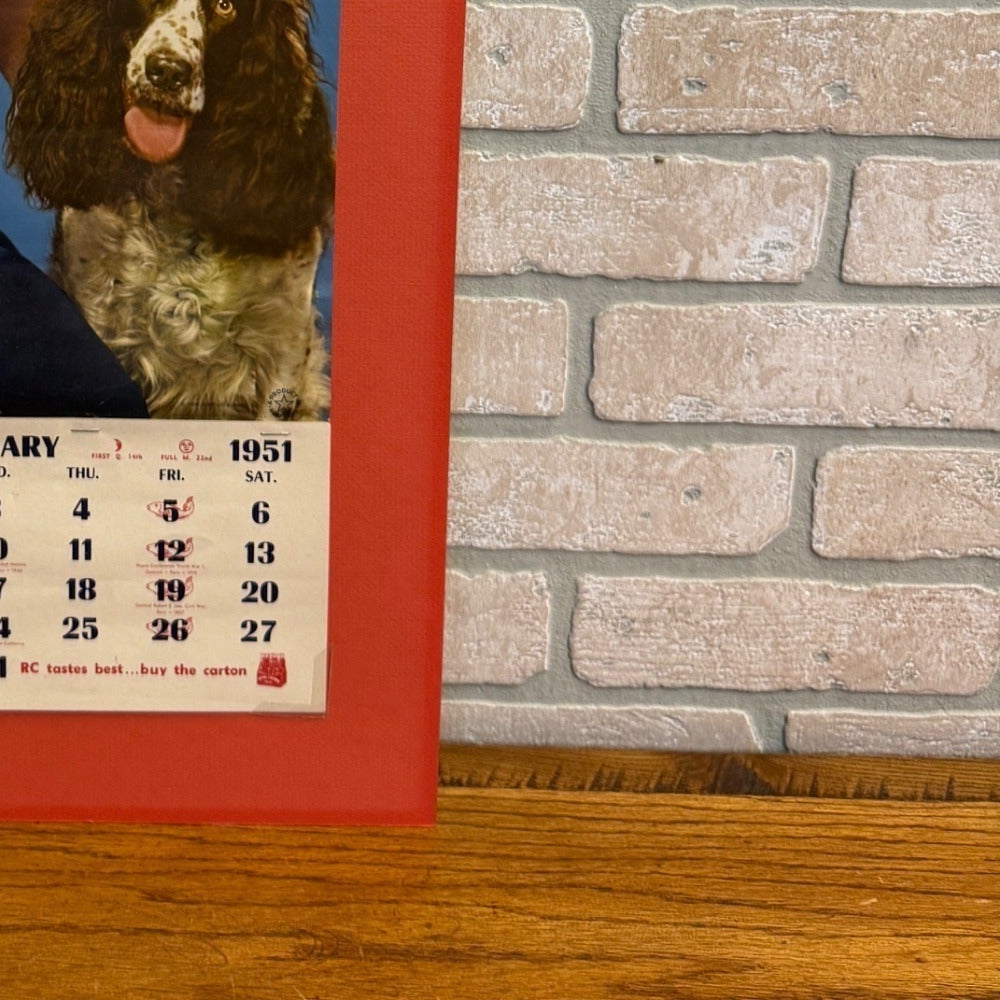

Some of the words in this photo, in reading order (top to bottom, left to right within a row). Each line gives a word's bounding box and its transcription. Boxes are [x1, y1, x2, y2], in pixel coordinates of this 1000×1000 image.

[230, 439, 292, 463] 1951
[66, 467, 99, 479] THU.
[159, 468, 185, 481] FRI.
[245, 470, 277, 483] SAT.
[72, 497, 91, 521] 4
[162, 499, 180, 523] 5
[251, 501, 270, 524] 6
[69, 538, 92, 561] 11
[154, 539, 186, 562] 12
[245, 541, 275, 564] 13
[66, 577, 97, 601] 18
[154, 578, 186, 602] 19
[241, 580, 279, 604] 20
[62, 616, 99, 640] 25
[151, 618, 189, 642] 26
[240, 619, 277, 643] 27
[19, 661, 38, 675] RC
[46, 664, 87, 676] tastes
[173, 665, 196, 676] the
[203, 666, 247, 677] carton
